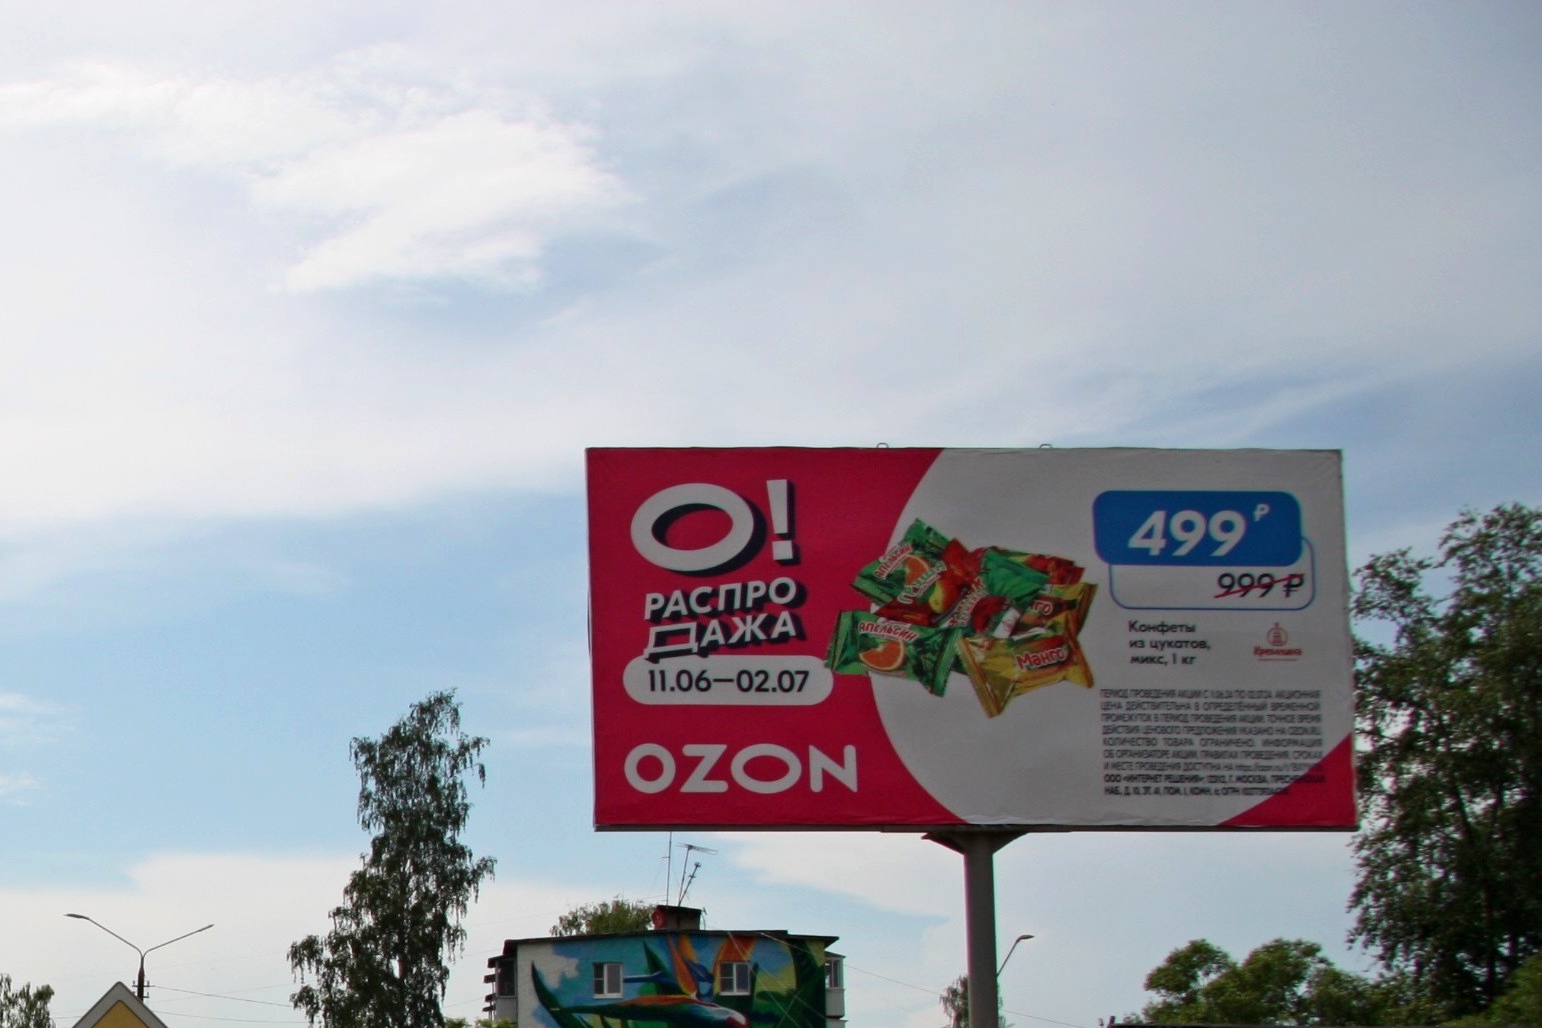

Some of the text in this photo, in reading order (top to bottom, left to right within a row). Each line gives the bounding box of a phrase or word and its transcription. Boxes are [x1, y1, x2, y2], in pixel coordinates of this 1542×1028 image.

[630, 479, 796, 573] О!
[1127, 509, 1247, 557] 499
[644, 577, 800, 622] РАСПРО
[1216, 572, 1275, 598] 999
[643, 611, 800, 660] ДАЖА
[1128, 620, 1197, 635] Конфеты
[1016, 647, 1069, 671] Манго
[1129, 640, 1211, 651] из цукатов,
[1130, 655, 1169, 666] микс,
[1182, 656, 1197, 665] кг
[624, 742, 858, 794] OZON
